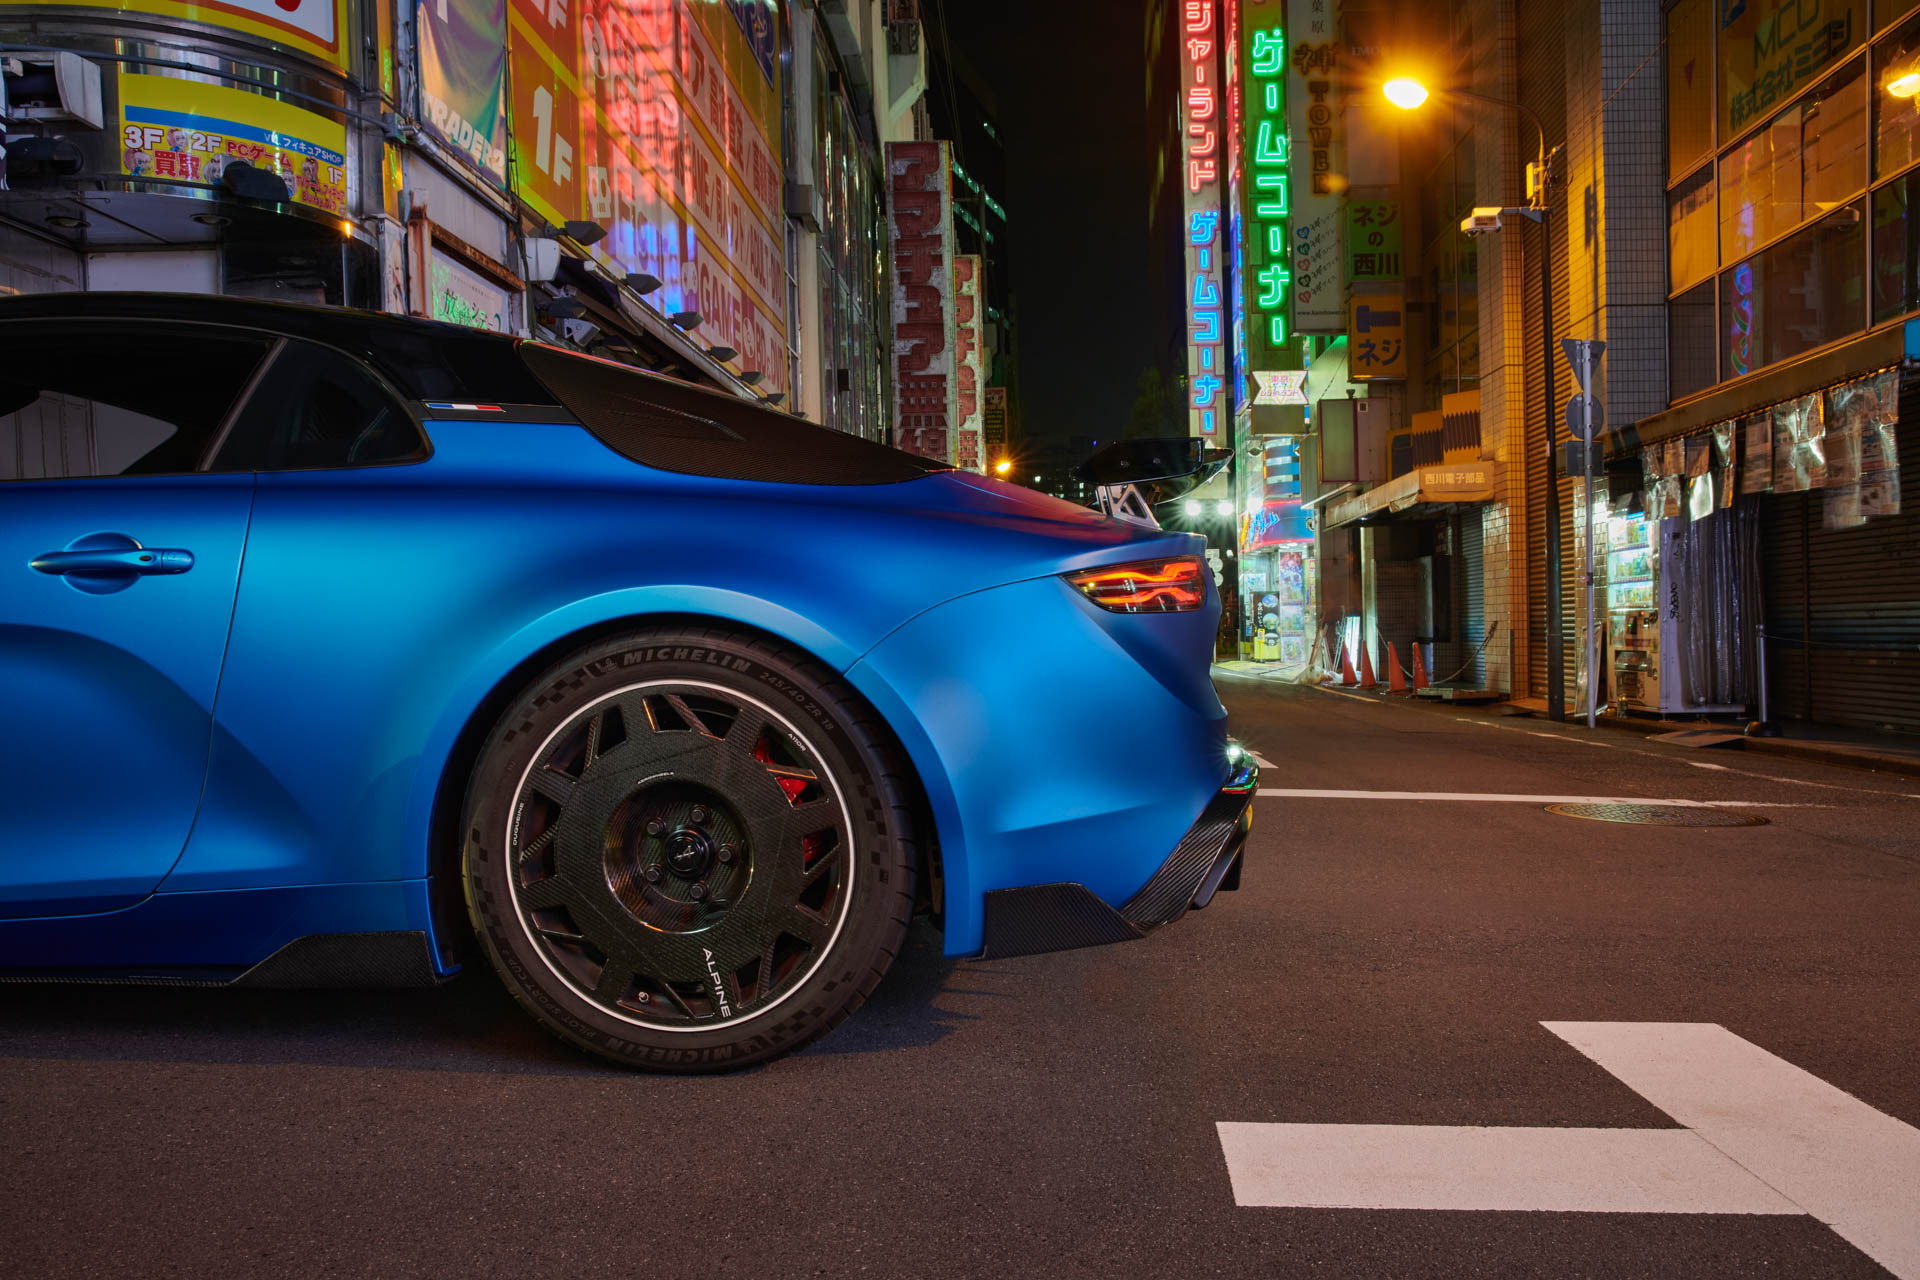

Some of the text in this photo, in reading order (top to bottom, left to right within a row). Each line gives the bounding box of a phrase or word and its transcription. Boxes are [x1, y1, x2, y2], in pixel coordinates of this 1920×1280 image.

[124, 125, 222, 153] 3F 2F
[533, 84, 572, 187] 1F
[154, 149, 202, 180] 買取
[225, 140, 292, 166] PCゲーム
[327, 166, 343, 186] 1F
[1251, 28, 1290, 346] ゲームコーナー
[1352, 205, 1399, 227] ネジ
[1367, 230, 1385, 247] の
[1353, 252, 1399, 277] 西川
[700, 263, 742, 347] GAME
[1190, 210, 1221, 433] ゲームコーナー
[1357, 339, 1402, 368] ネジ
[1424, 472, 1486, 485] 西川電子部品
[623, 647, 752, 673] MICHELIN
[760, 671, 805, 703] 245/40
[702, 947, 732, 1018] ALPINE
[605, 1037, 732, 1064] MICHELIN
